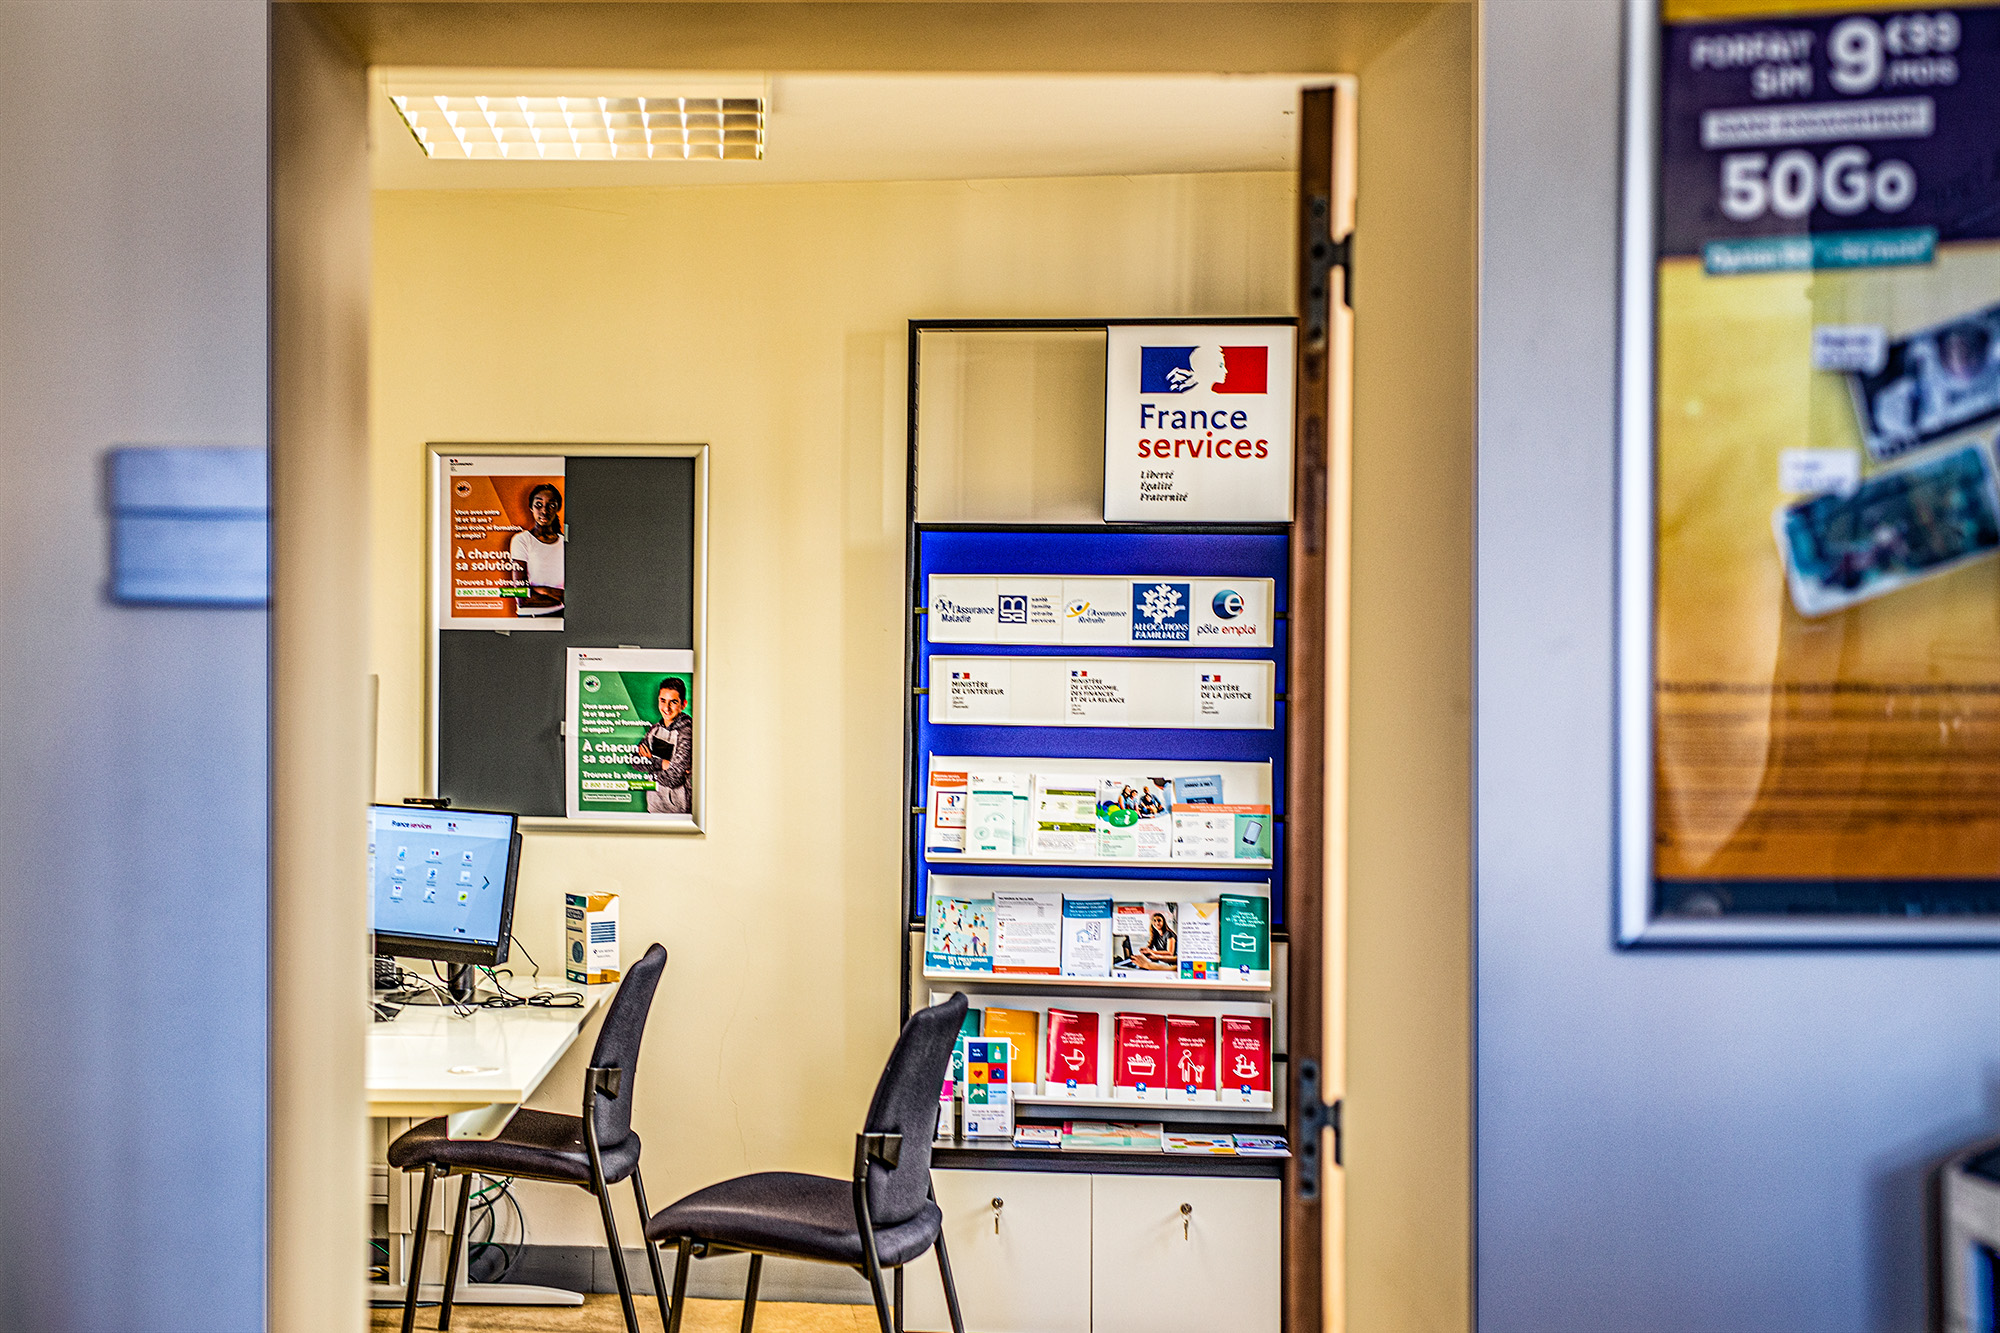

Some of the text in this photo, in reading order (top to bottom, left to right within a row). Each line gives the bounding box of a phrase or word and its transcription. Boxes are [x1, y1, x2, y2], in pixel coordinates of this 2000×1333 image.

[1828, 16, 1883, 94] 9
[1140, 403, 1248, 430] France
[1137, 430, 1269, 459] services
[1140, 470, 1175, 479] Liberté
[1140, 491, 1189, 502] Fraternité
[455, 546, 511, 560] À chacun
[455, 559, 524, 571] sa solution.
[455, 578, 485, 586] Trouvez
[486, 578, 493, 586] la
[941, 613, 971, 623] Maladie
[1133, 622, 1189, 631] ALLOCATIONS
[1197, 623, 1257, 637] pôle emploi
[1134, 631, 1187, 639] FAMILIALES
[952, 680, 989, 688] MINISTÈRE
[1201, 683, 1240, 691] MINISTÈRE
[1224, 692, 1253, 700] JUSTICE
[582, 739, 639, 753] À chacun
[582, 752, 653, 765] sa solution.
[582, 770, 613, 779] Trouvez
[613, 771, 621, 779] la
